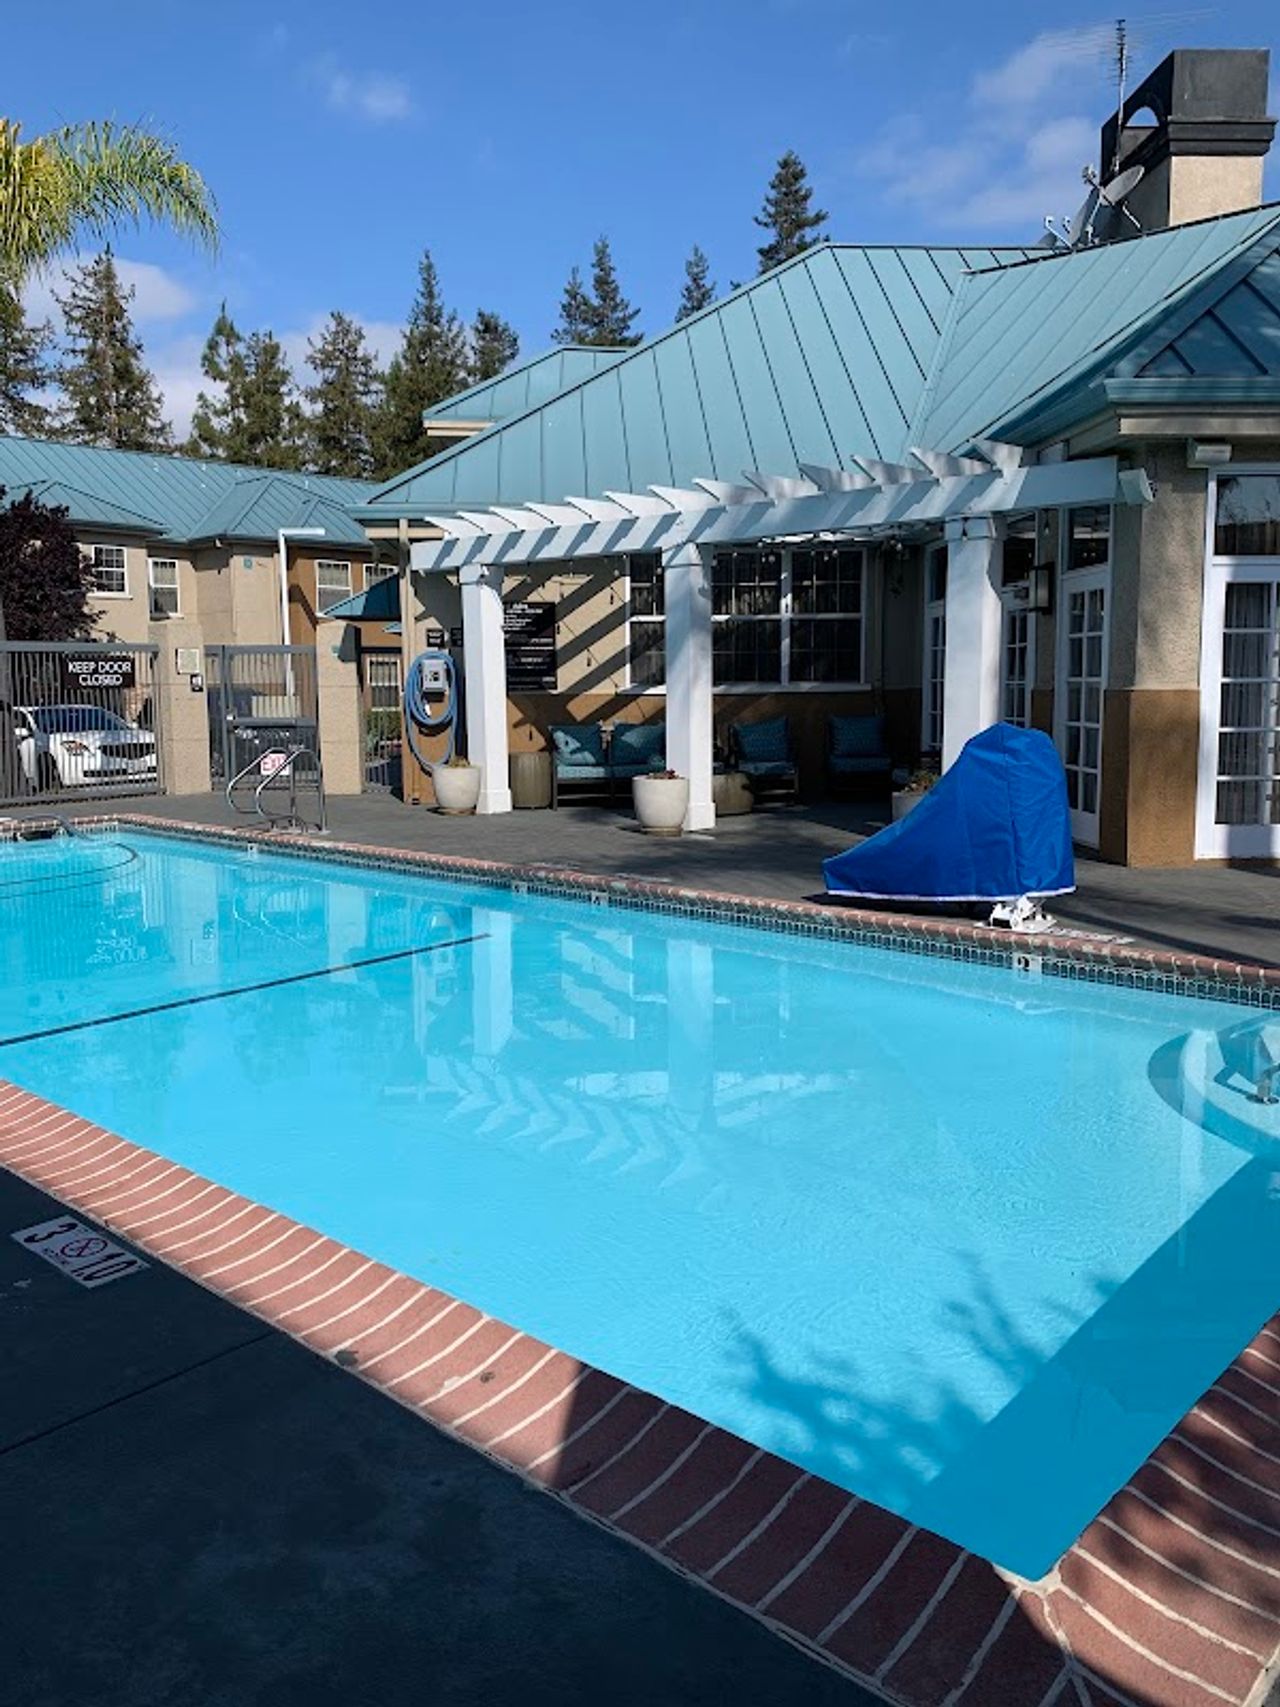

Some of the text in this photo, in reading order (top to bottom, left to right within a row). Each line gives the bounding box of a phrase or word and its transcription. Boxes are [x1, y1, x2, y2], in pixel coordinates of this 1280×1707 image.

[68, 661, 132, 673] KEEP DOOR
[78, 674, 123, 686] CLOSED
[24, 1222, 78, 1243] 3
